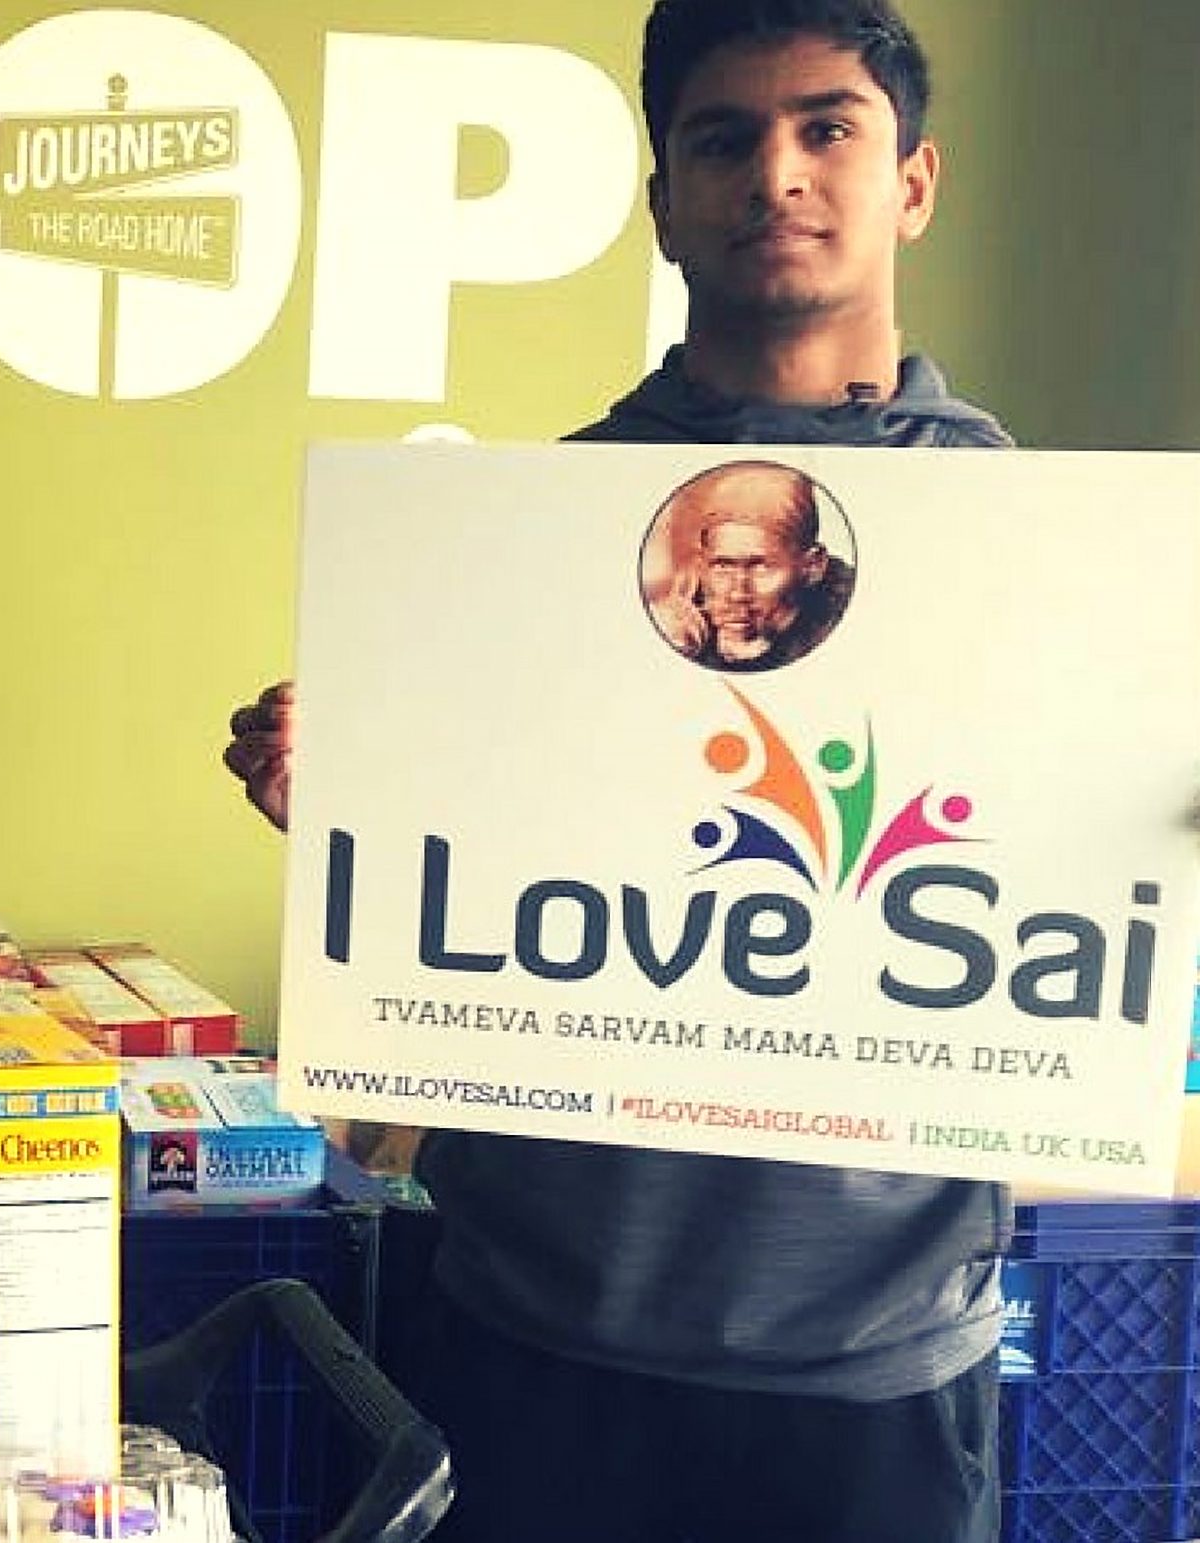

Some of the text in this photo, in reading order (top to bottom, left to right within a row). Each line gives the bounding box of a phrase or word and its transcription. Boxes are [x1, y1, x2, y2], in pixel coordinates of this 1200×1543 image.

[3, 116, 231, 195] JOURNEYS
[28, 210, 217, 261] THE ROAD HOME
[325, 827, 1162, 1026] I Love Sai
[371, 997, 1074, 1080] TVAMEVA SARVAM MAMA DEVA DEVA
[0, 1134, 101, 1165] Cheerios
[302, 1065, 594, 1114] WWW.ILOVESAI.COM
[1021, 1132, 1071, 1158] UK
[1080, 1138, 1147, 1166] USA
